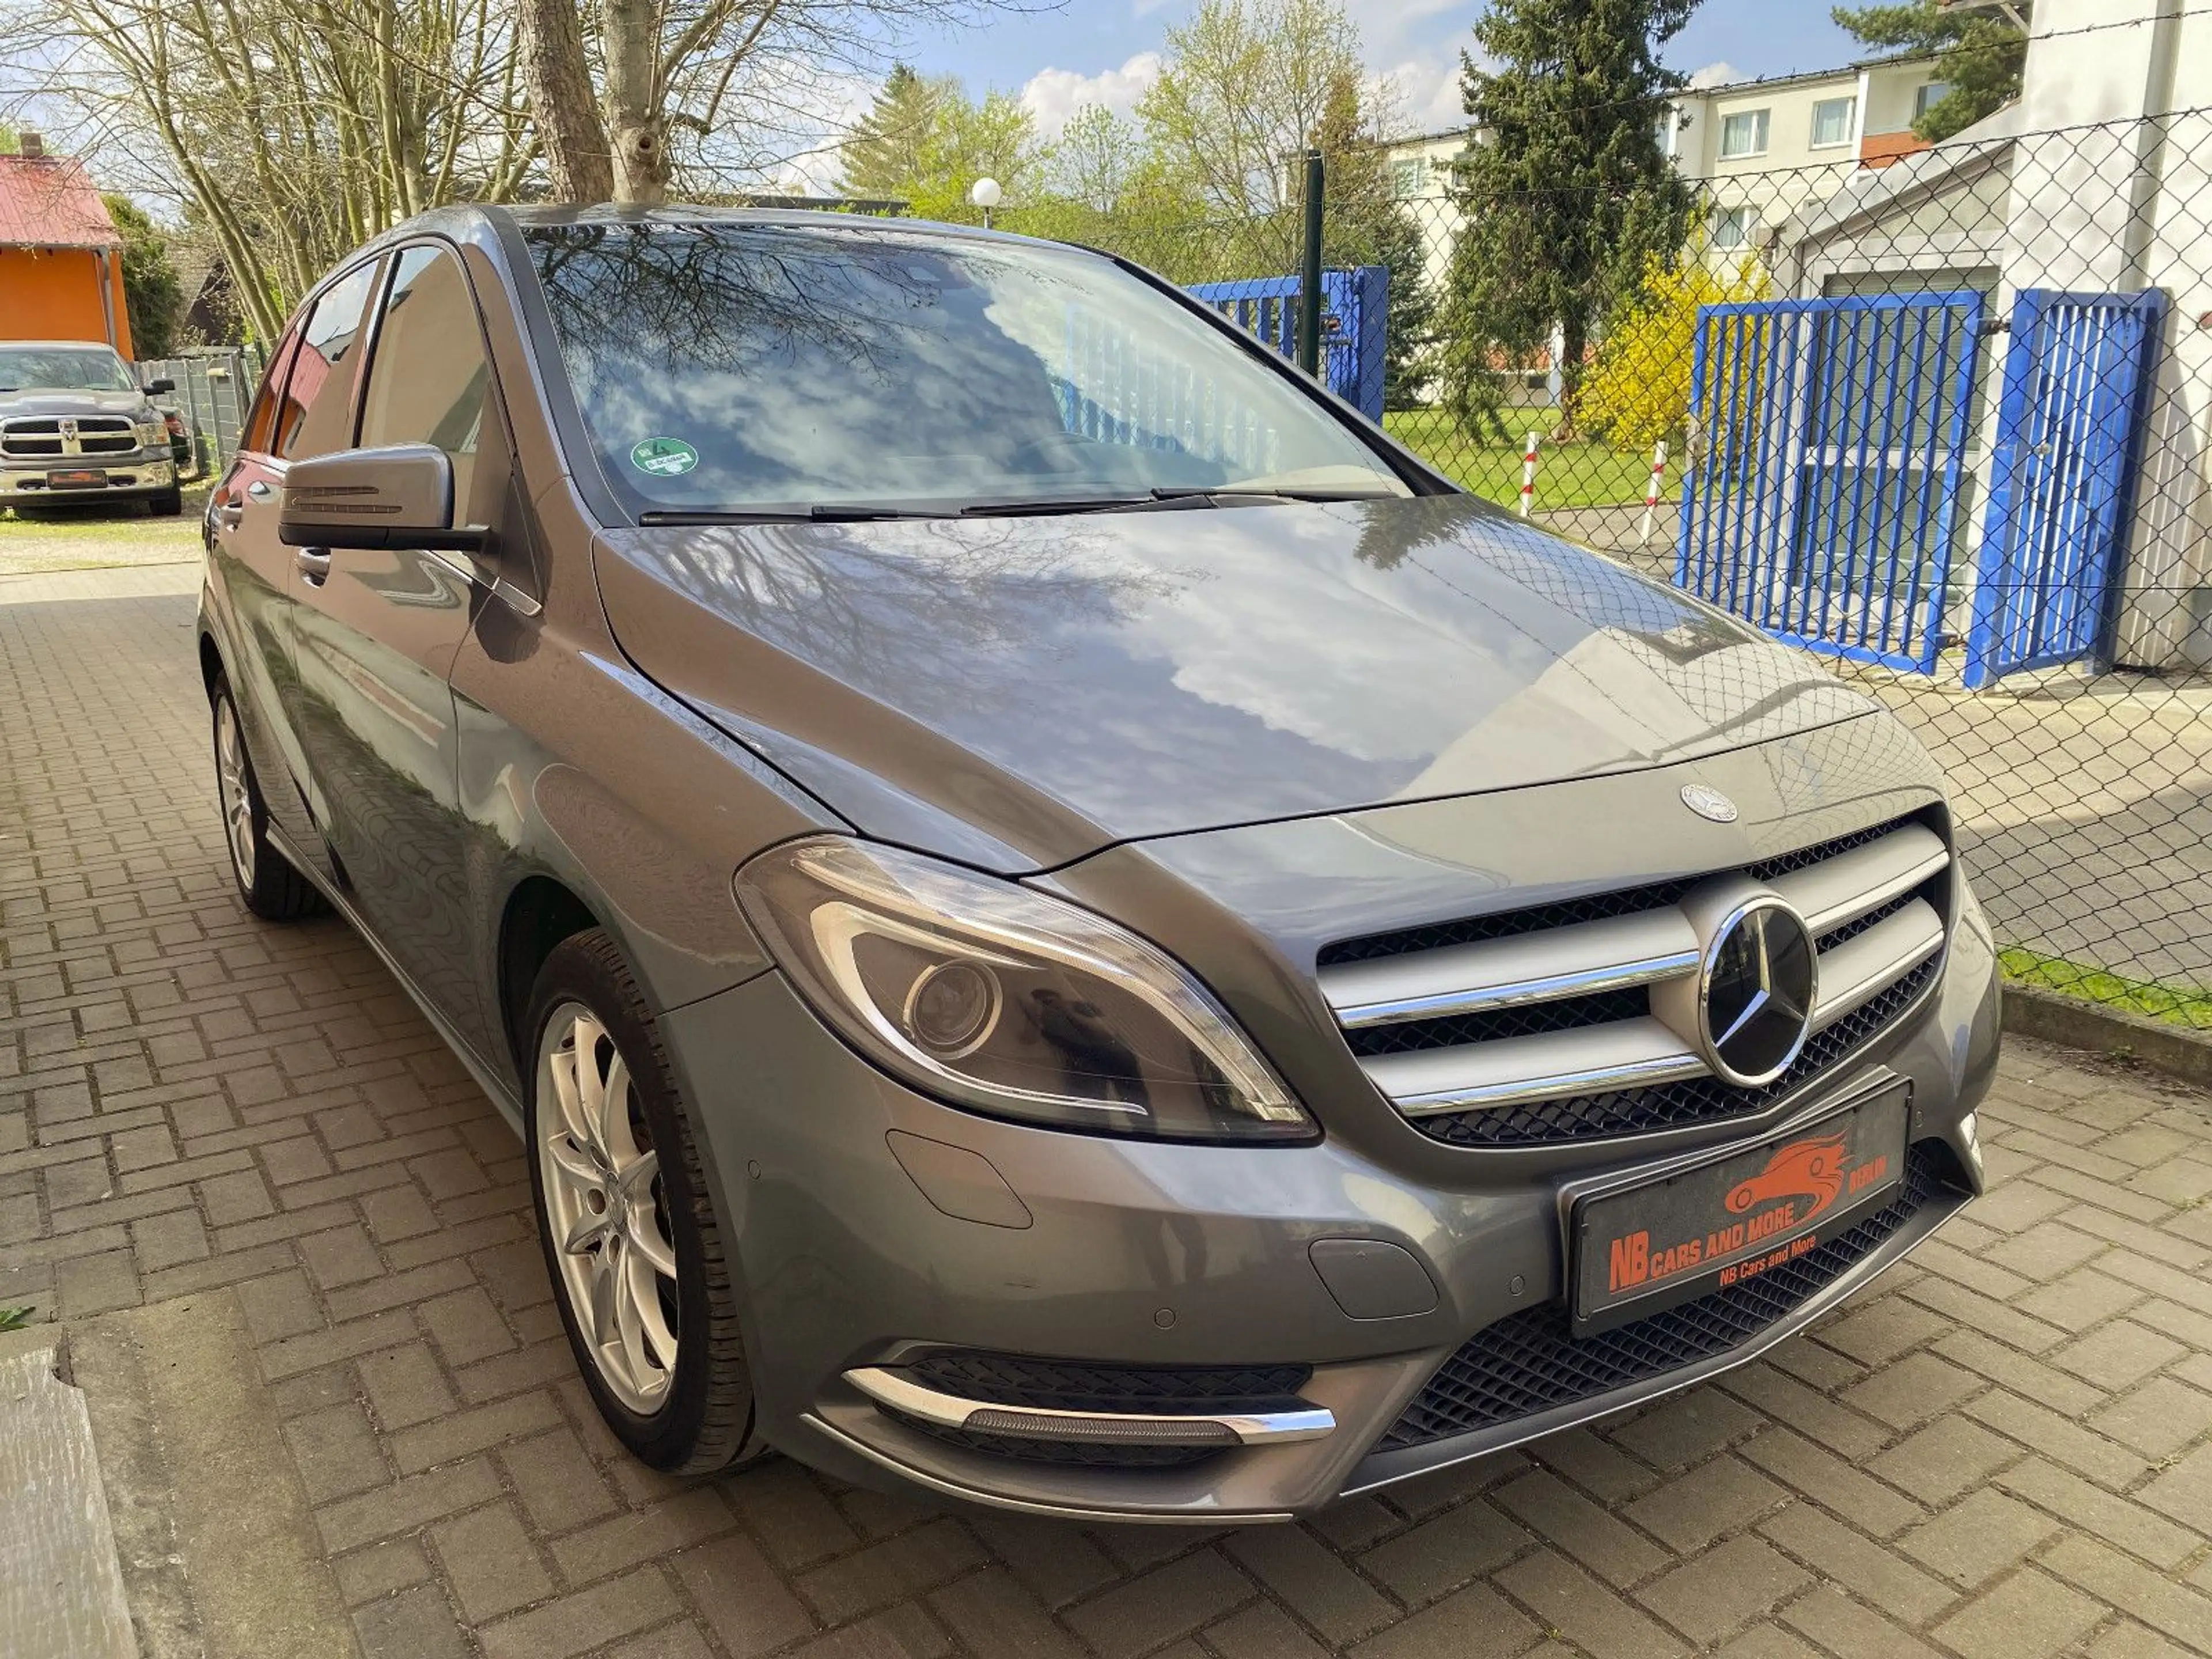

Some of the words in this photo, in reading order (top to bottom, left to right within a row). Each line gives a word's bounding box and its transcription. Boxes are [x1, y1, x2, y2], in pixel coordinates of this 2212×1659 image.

[1609, 1230, 1649, 1290] NB
[1650, 1240, 1701, 1277] CARS
[1705, 1224, 1743, 1259] AND
[1748, 1202, 1794, 1242] MORE
[1720, 1267, 1737, 1286] NB
[1740, 1257, 1766, 1278] Cars
[1768, 1246, 1788, 1267] and
[1791, 1235, 1816, 1257] More
